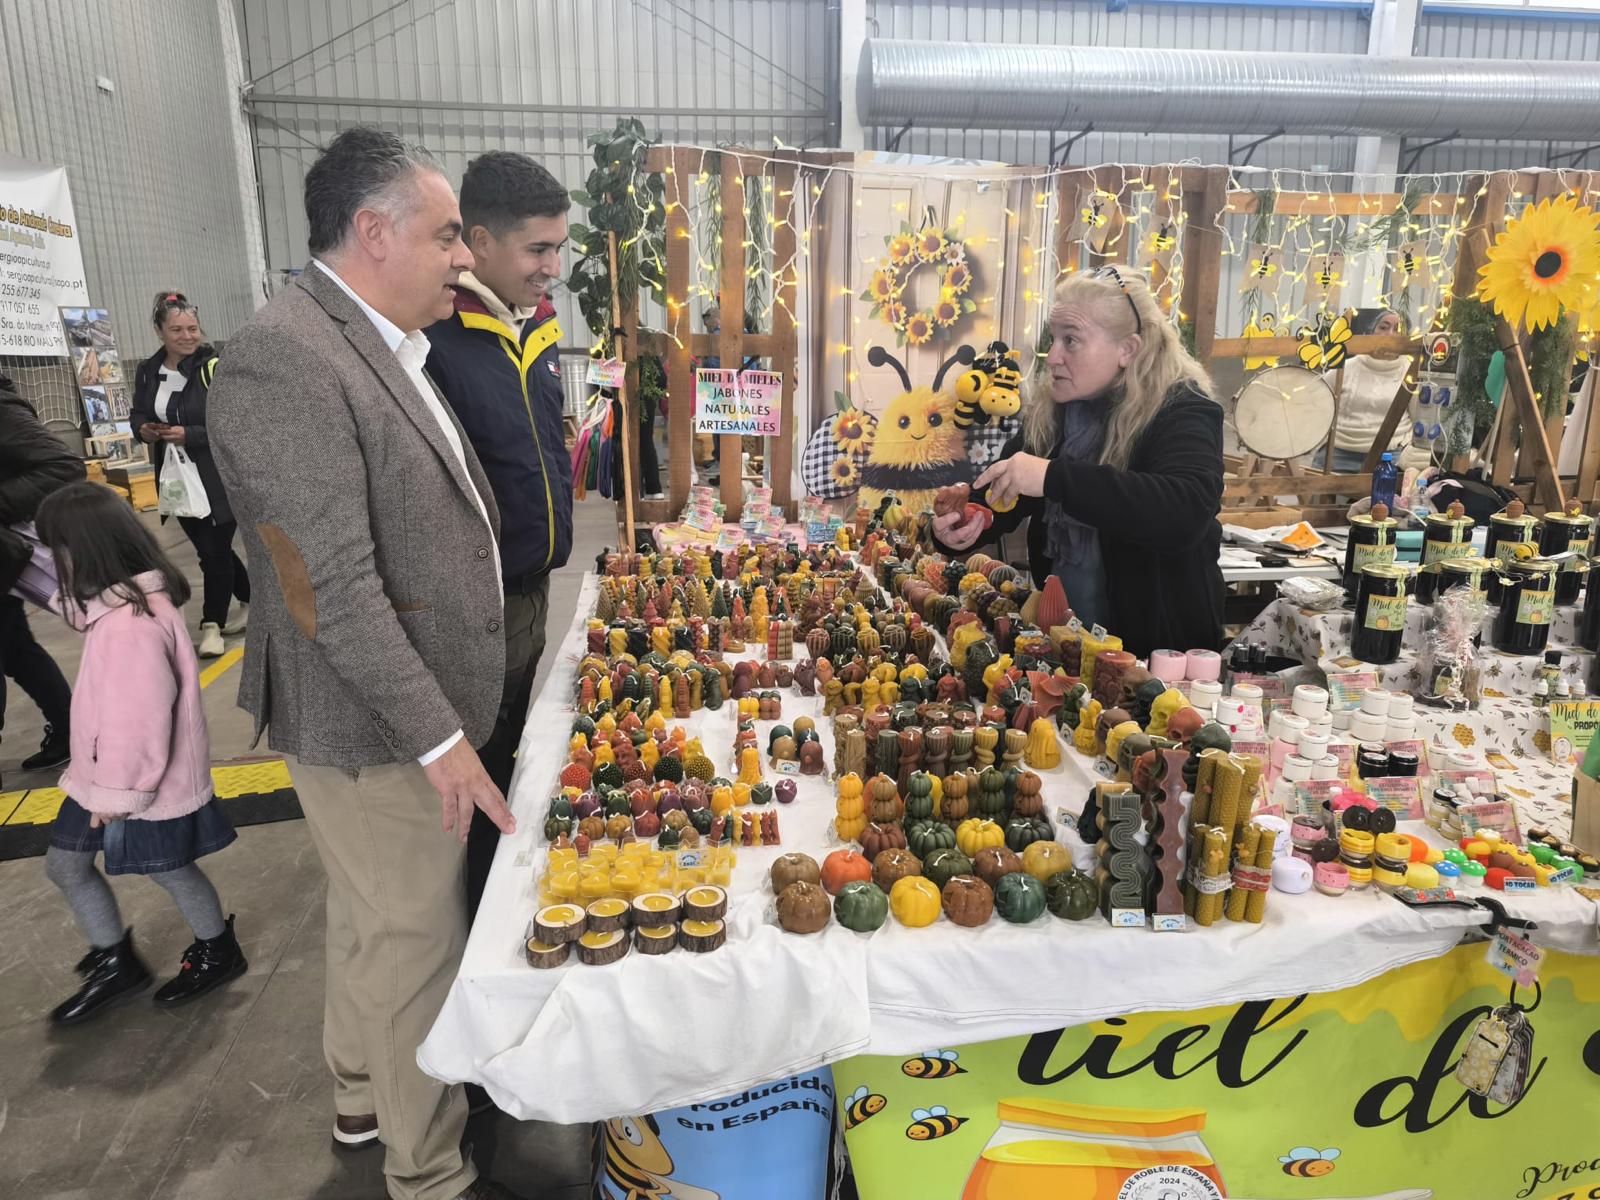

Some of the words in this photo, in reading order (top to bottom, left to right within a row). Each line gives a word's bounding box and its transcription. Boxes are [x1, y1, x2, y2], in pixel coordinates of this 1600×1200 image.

[8, 204, 19, 225] de
[1, 284, 15, 296] 255
[16, 286, 28, 297] 677
[29, 287, 41, 299] 345
[698, 373, 723, 383] MIEL
[745, 374, 781, 386] MIELES
[713, 388, 762, 399] JABONES
[705, 404, 770, 416] NATURALES
[699, 420, 776, 432] ARTESANALES
[1499, 943, 1528, 966] TERMICO
[676, 1115, 715, 1132] en
[722, 1097, 832, 1130] España
[1123, 1178, 1136, 1190] DE
[1133, 1165, 1165, 1180] ROBLE
[1181, 1166, 1216, 1192] ESPAÑA
